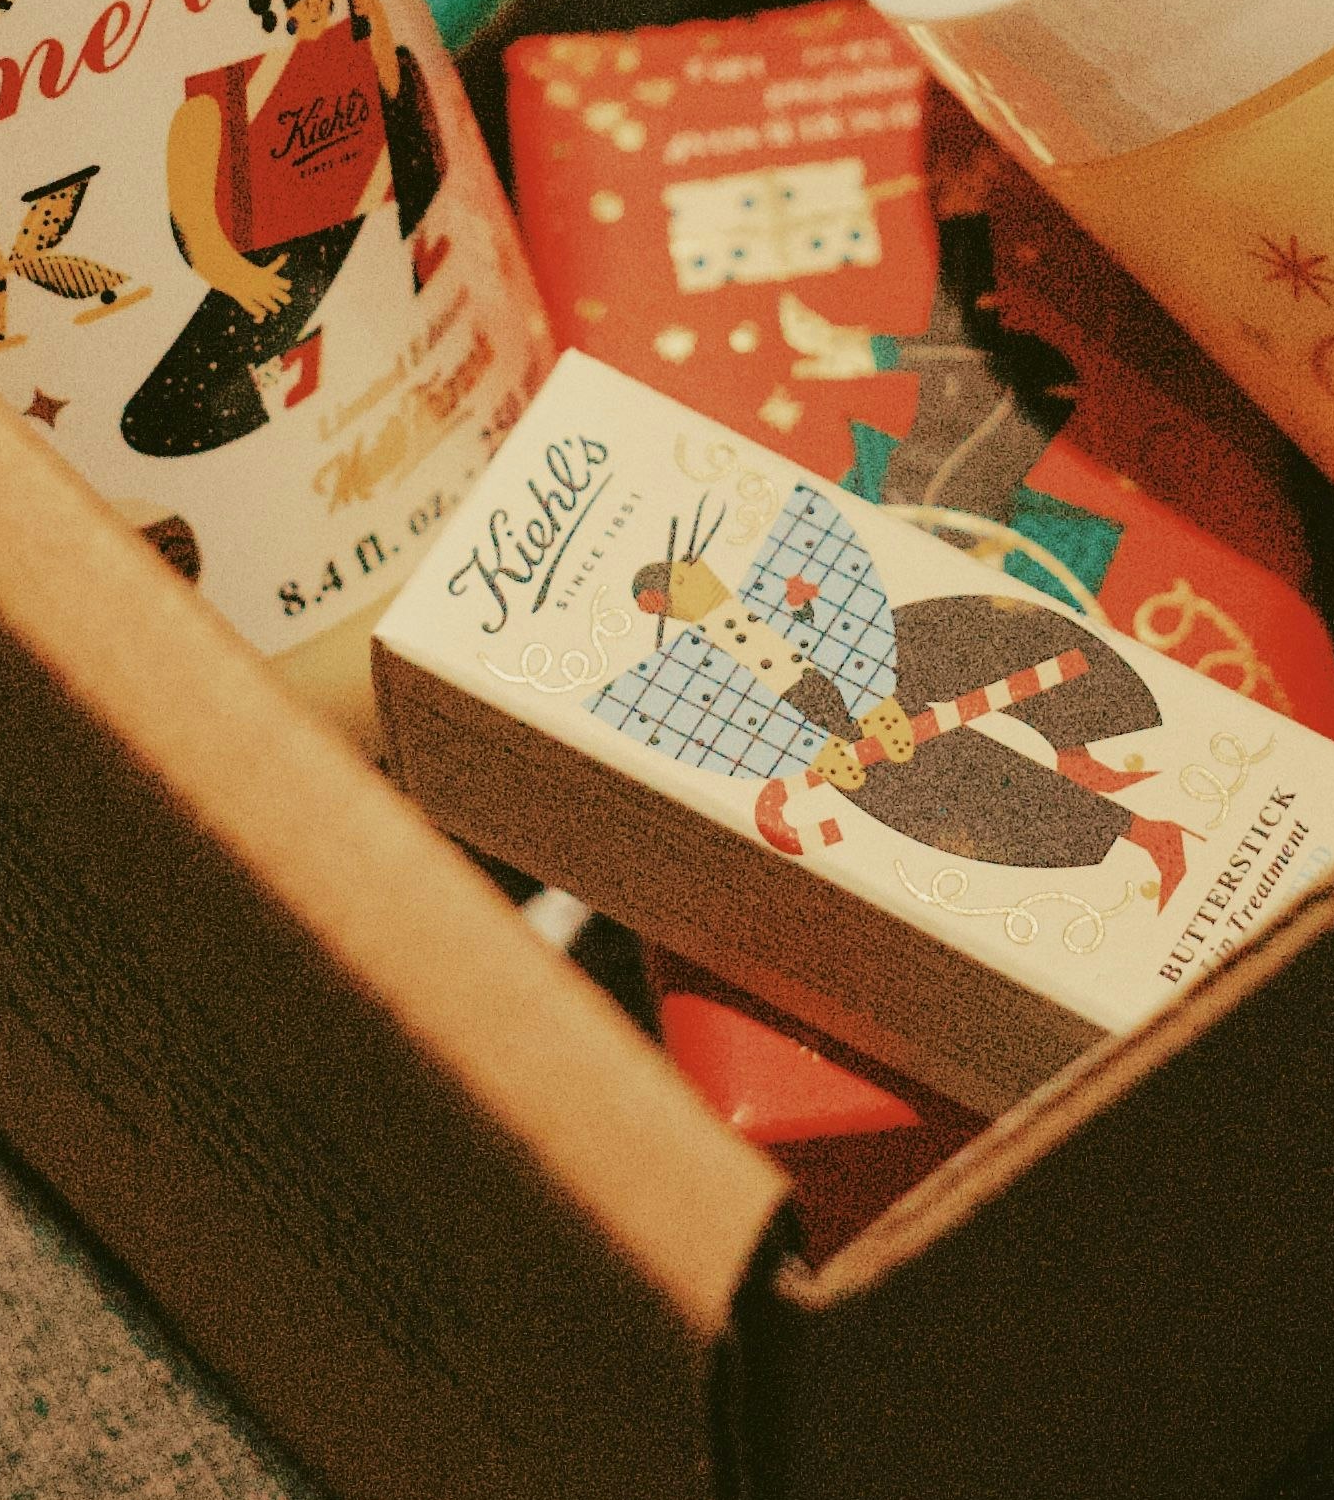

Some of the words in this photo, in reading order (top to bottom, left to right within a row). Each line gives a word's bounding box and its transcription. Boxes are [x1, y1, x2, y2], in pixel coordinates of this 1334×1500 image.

[270, 83, 369, 159] Kiehl's
[276, 560, 344, 618] 8.4
[354, 530, 401, 575] fl.
[448, 435, 608, 634] Kiehl's
[556, 549, 605, 611] SINCE
[604, 491, 644, 540] 1851
[1157, 784, 1297, 985] BUTTERSTICK
[1226, 818, 1311, 933] Treatment
